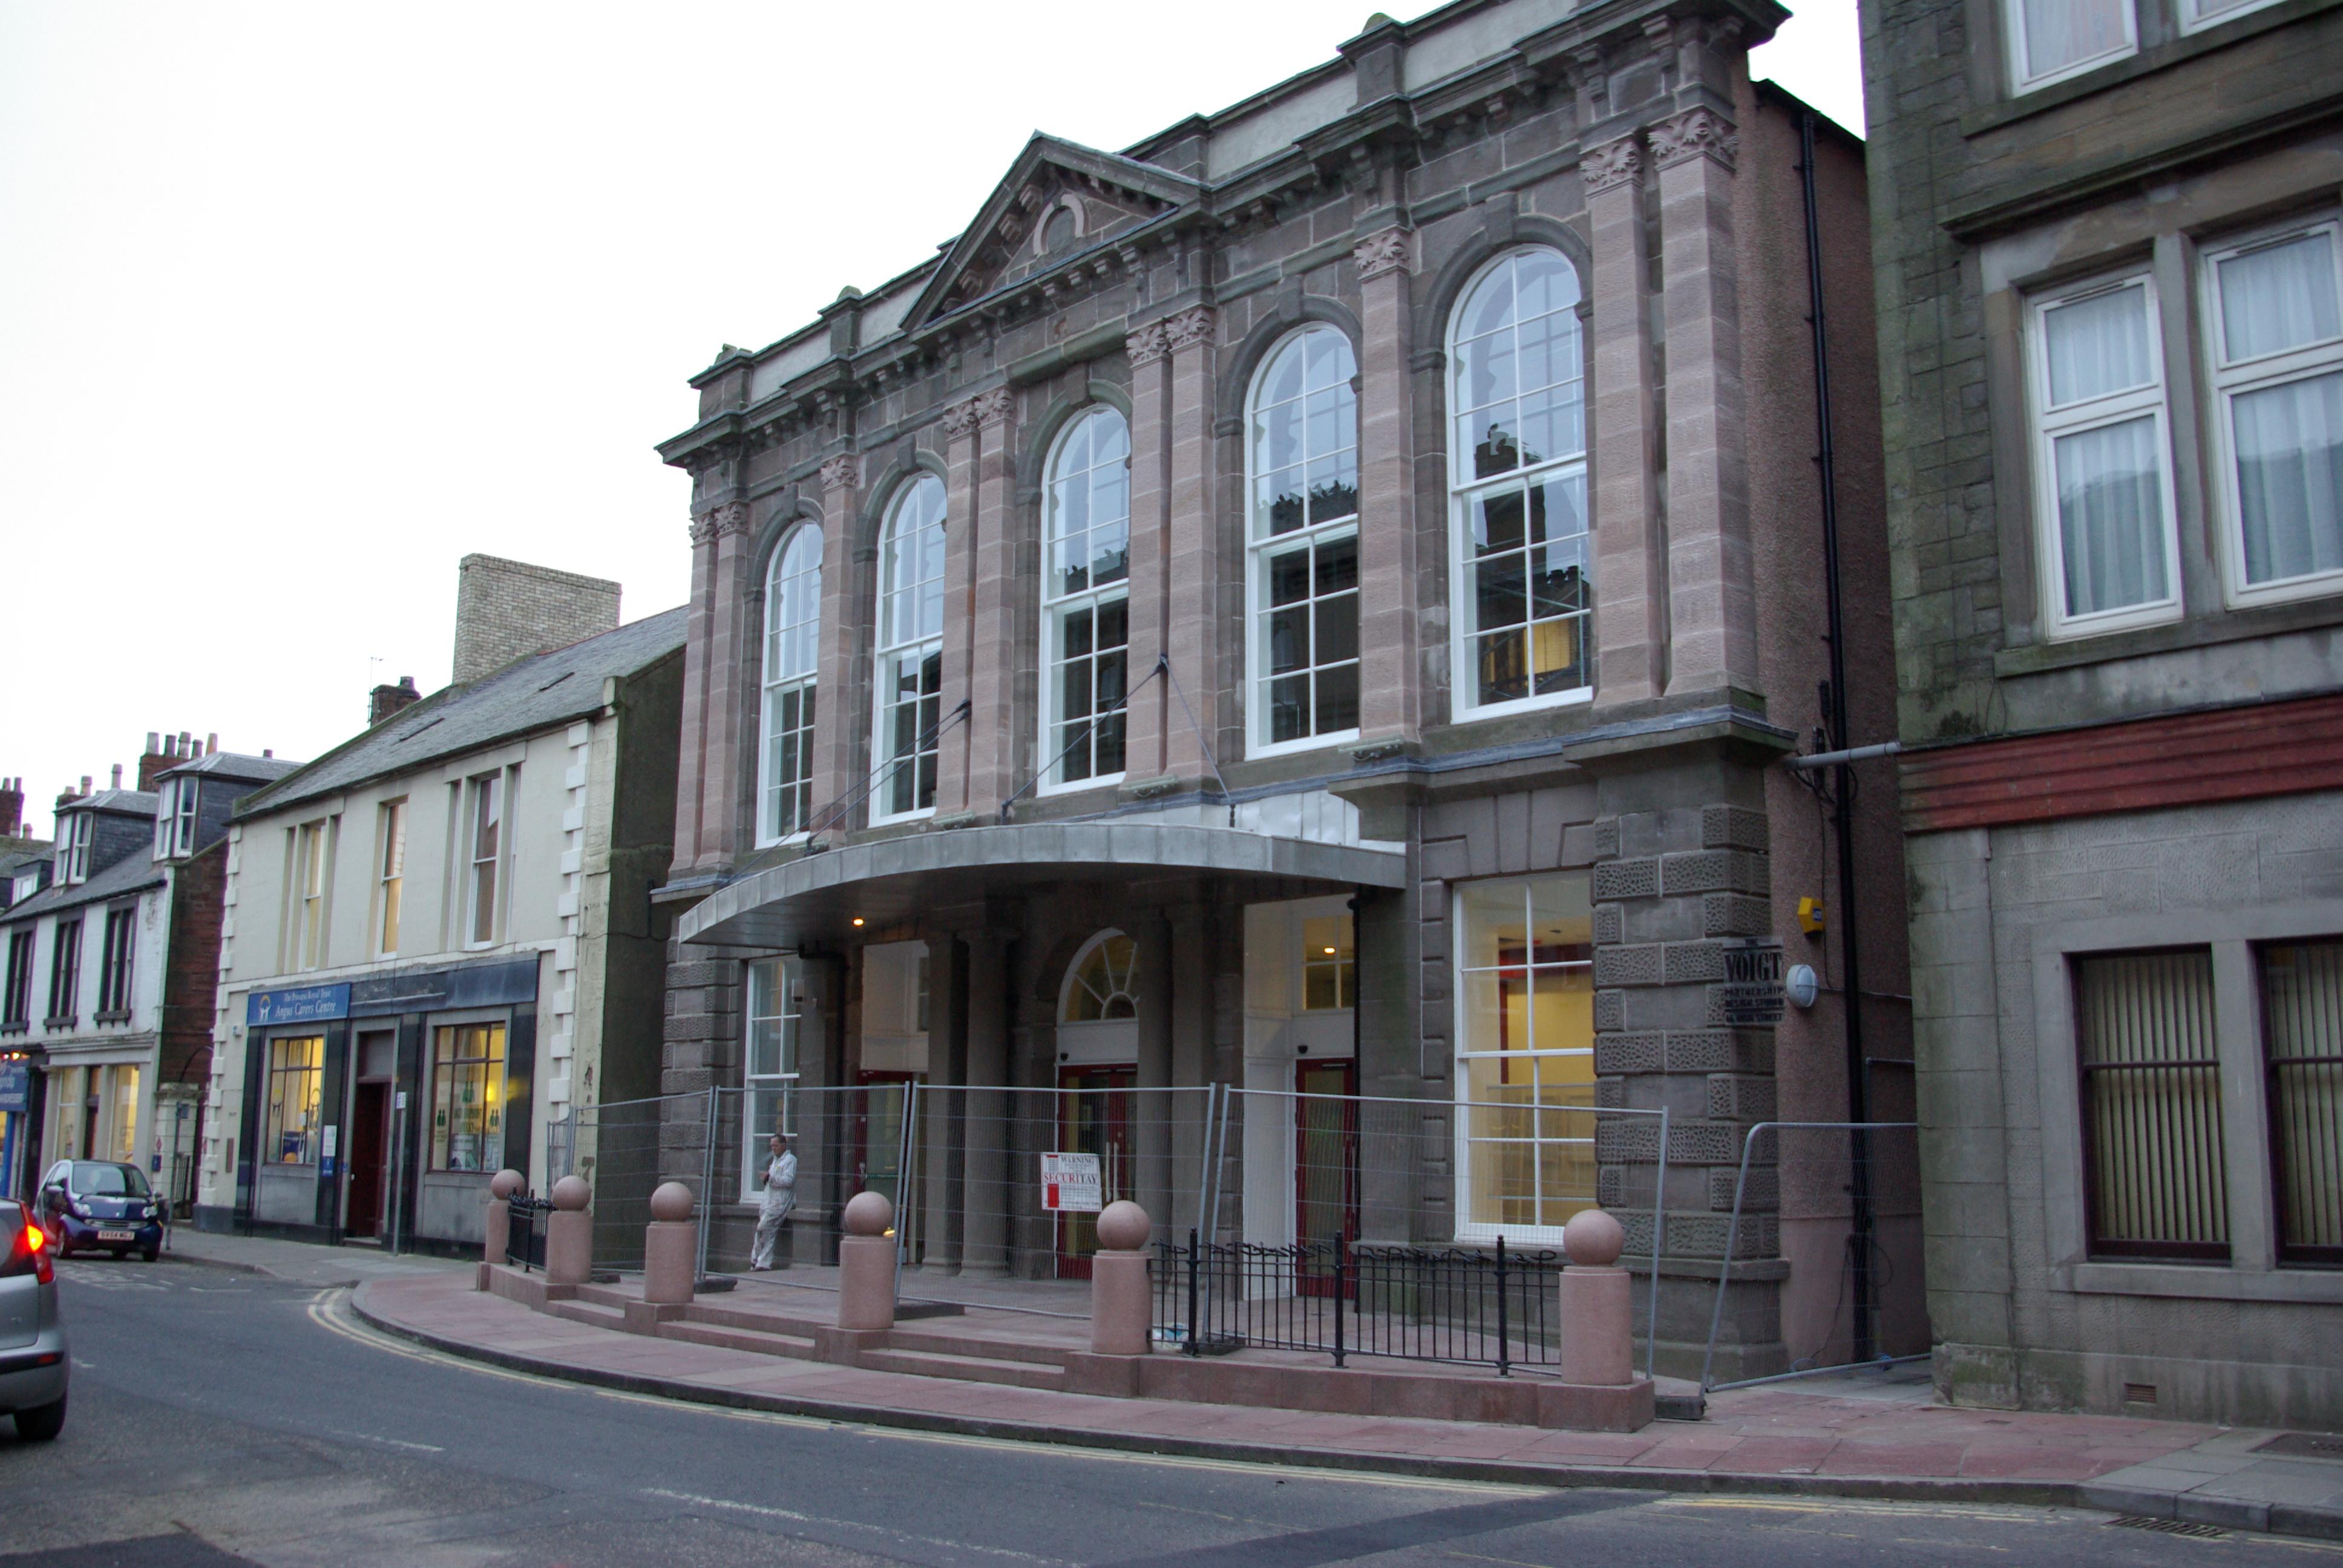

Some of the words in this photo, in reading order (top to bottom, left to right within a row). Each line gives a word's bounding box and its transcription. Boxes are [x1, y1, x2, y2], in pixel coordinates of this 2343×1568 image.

[1725, 952, 1783, 982] VOIGT
[1725, 987, 1784, 996] PARTNERSHIP
[275, 1005, 293, 1019] Angus
[295, 1002, 313, 1014] Carers
[315, 1000, 336, 1013] Centre
[1755, 1013, 1783, 1021] STREET
[1061, 1156, 1094, 1165] WARNING
[1044, 1172, 1096, 1184] SECURITAY
